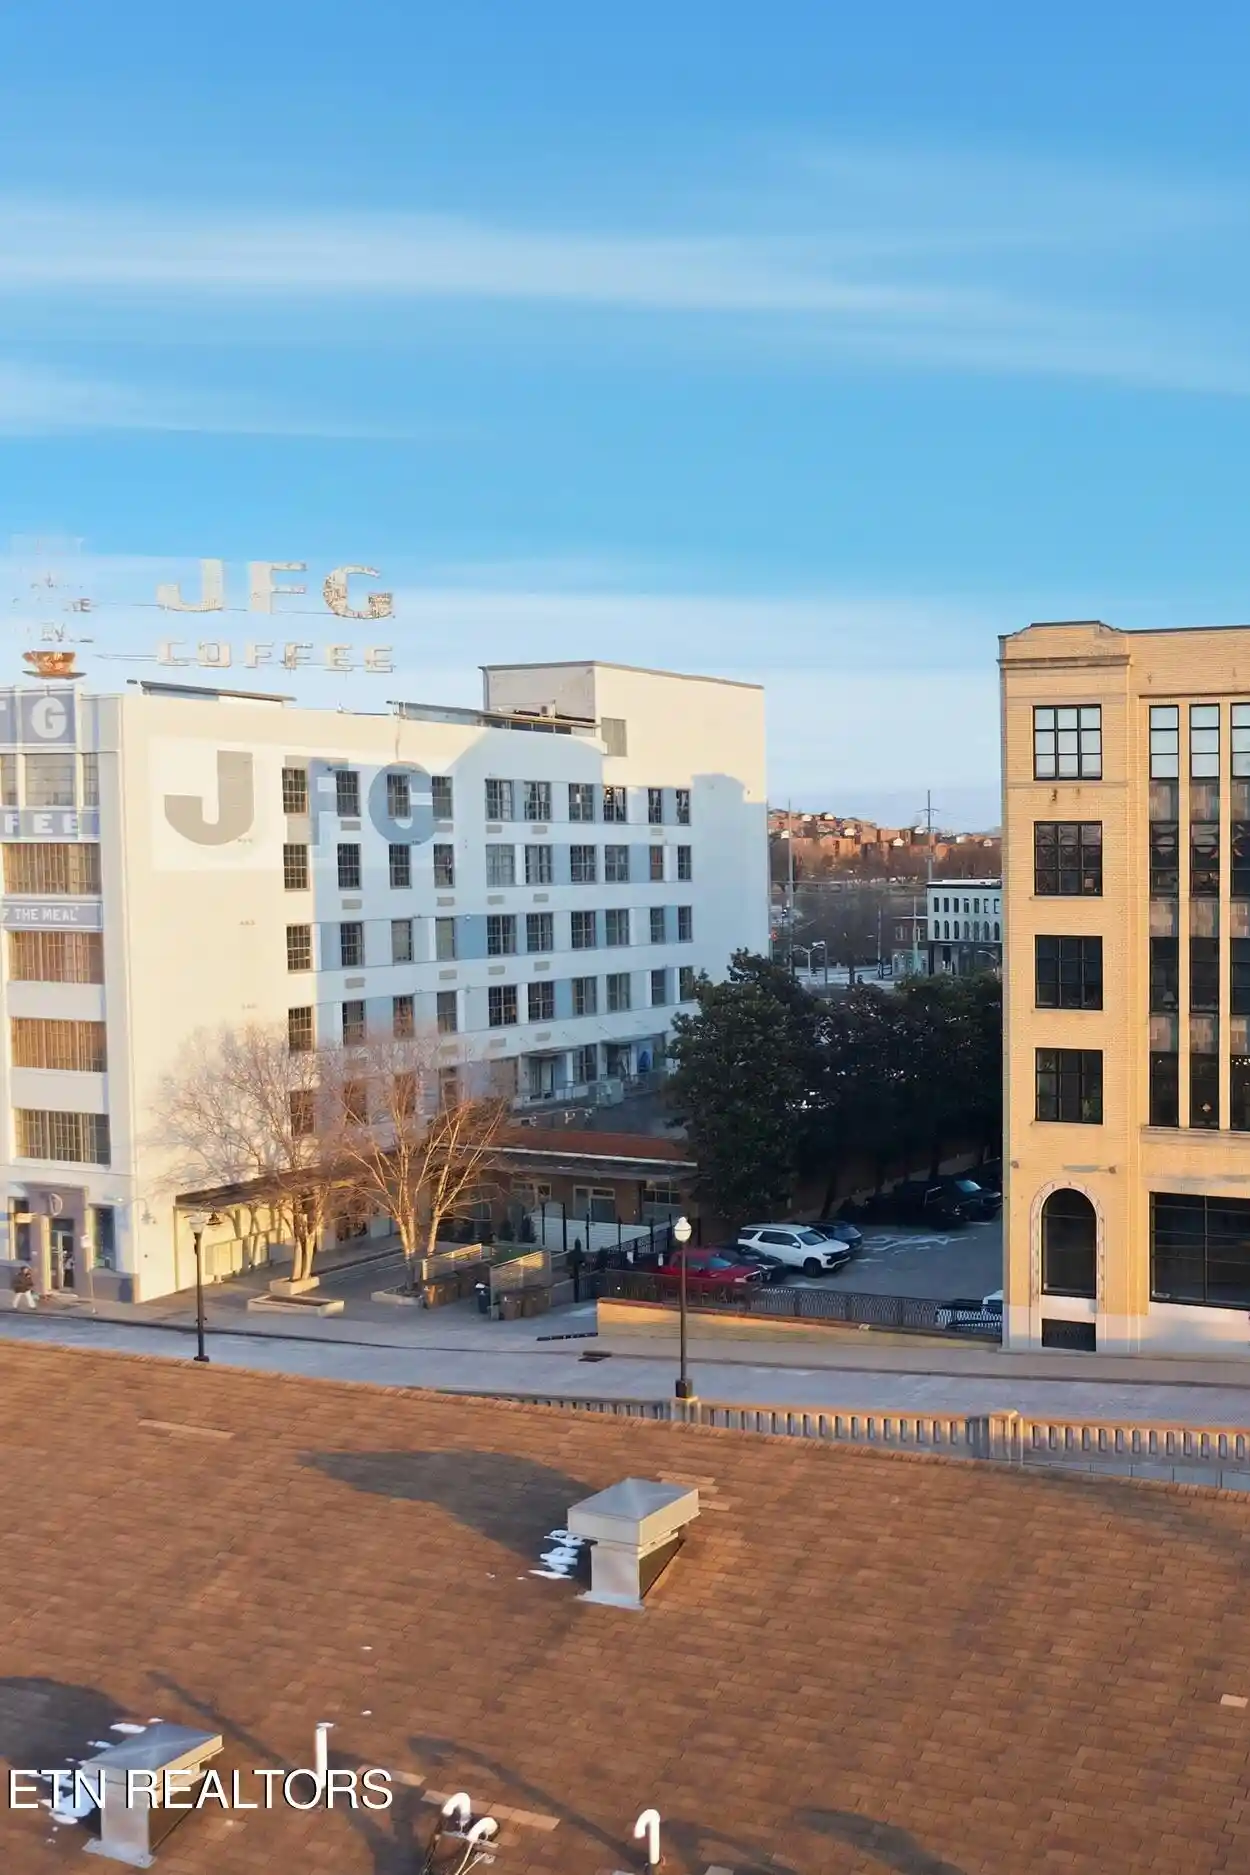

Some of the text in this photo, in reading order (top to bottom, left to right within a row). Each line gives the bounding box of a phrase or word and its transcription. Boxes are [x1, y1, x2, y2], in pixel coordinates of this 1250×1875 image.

[156, 558, 393, 620] JFG
[156, 640, 393, 673] COFFEE
[164, 750, 440, 846] JFG
[15, 908, 39, 921] THE
